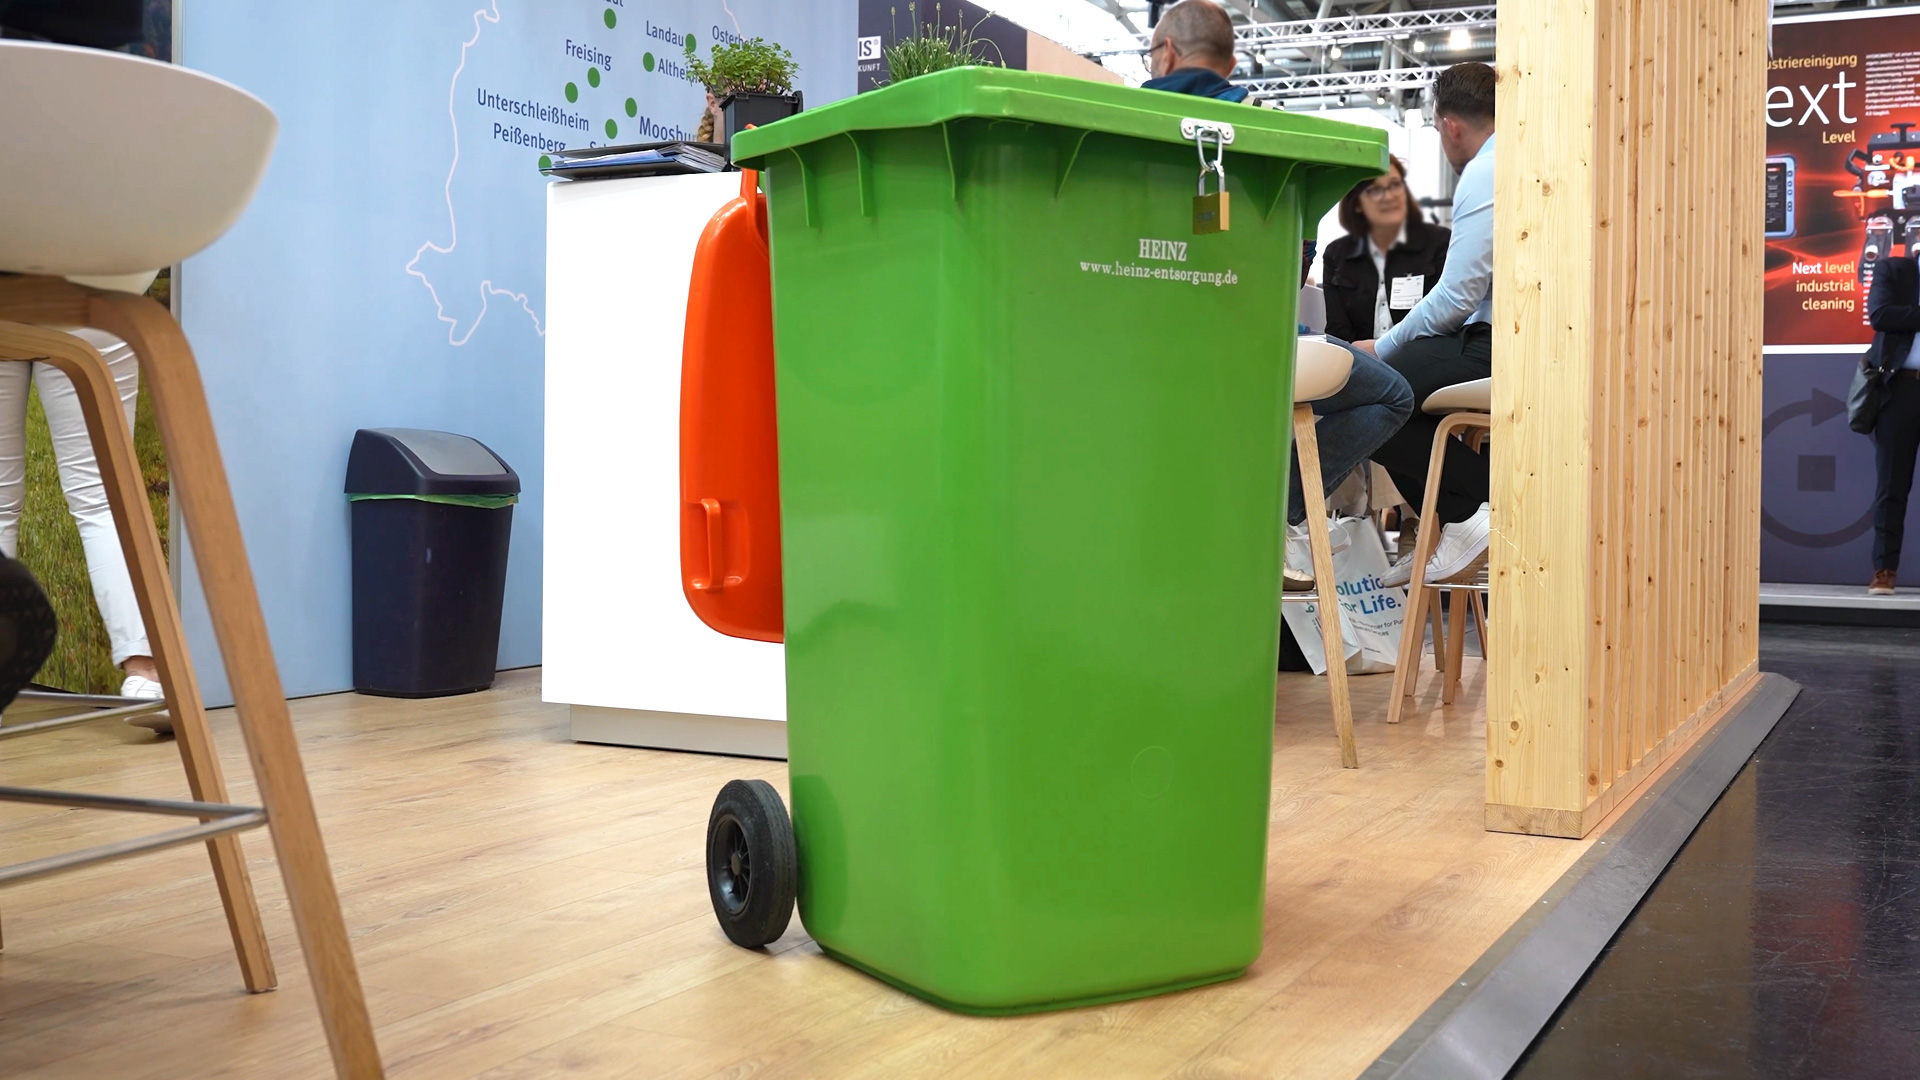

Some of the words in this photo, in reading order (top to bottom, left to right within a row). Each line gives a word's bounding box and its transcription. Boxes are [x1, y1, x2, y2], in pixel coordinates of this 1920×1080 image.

[646, 20, 684, 47] Landau
[712, 25, 754, 49] Osterh
[565, 39, 612, 72] Freising
[477, 87, 590, 132] Unterschleißheim
[493, 122, 567, 158] Peißenberg
[1822, 129, 1856, 144] Level
[1138, 238, 1188, 262] HEINZ
[1080, 261, 1238, 287] www.heinz-entsorgung.de
[1792, 262, 1822, 275] Next
[1825, 261, 1856, 274] level
[1796, 279, 1855, 293] industrial
[1802, 297, 1855, 312] cleaning
[1359, 594, 1402, 615] Life.
